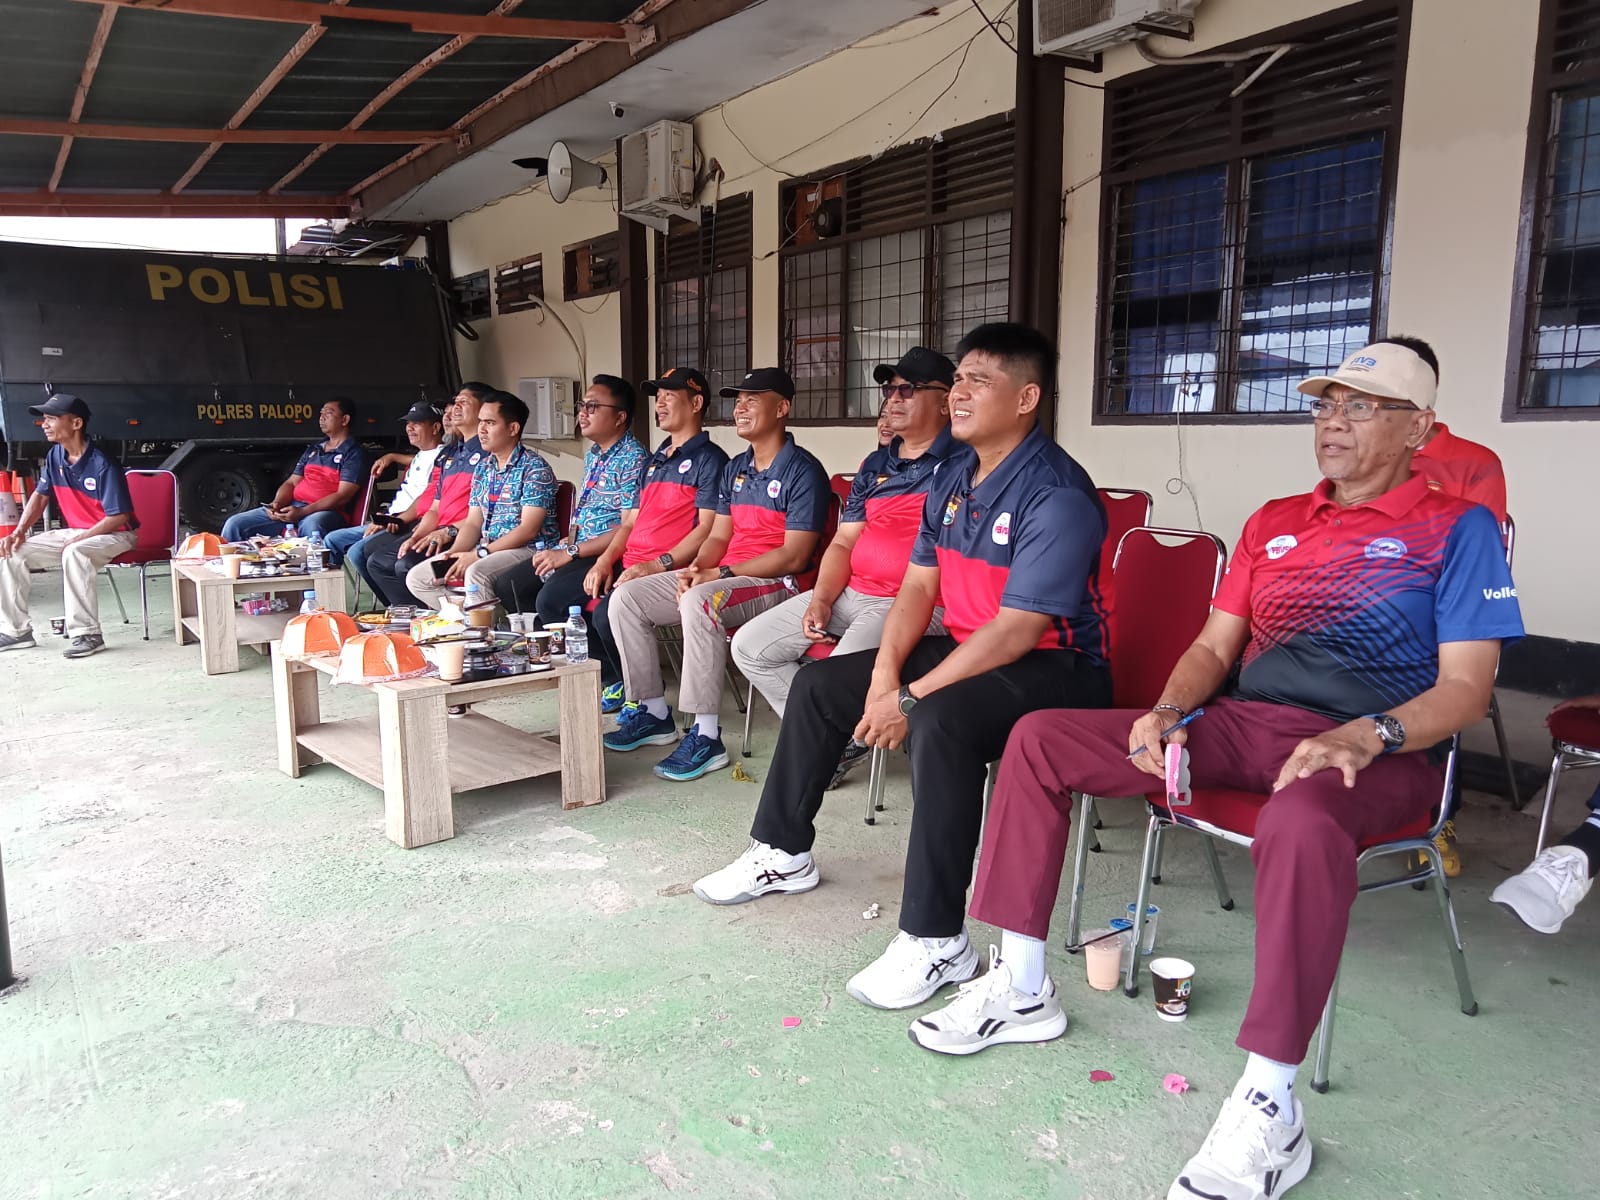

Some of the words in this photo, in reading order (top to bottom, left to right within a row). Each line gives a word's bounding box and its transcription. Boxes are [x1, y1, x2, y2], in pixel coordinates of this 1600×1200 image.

[145, 264, 343, 310] POLISI
[197, 403, 254, 420] POLRES
[259, 403, 313, 419] PALOPO
[1482, 586, 1518, 600] Volle
